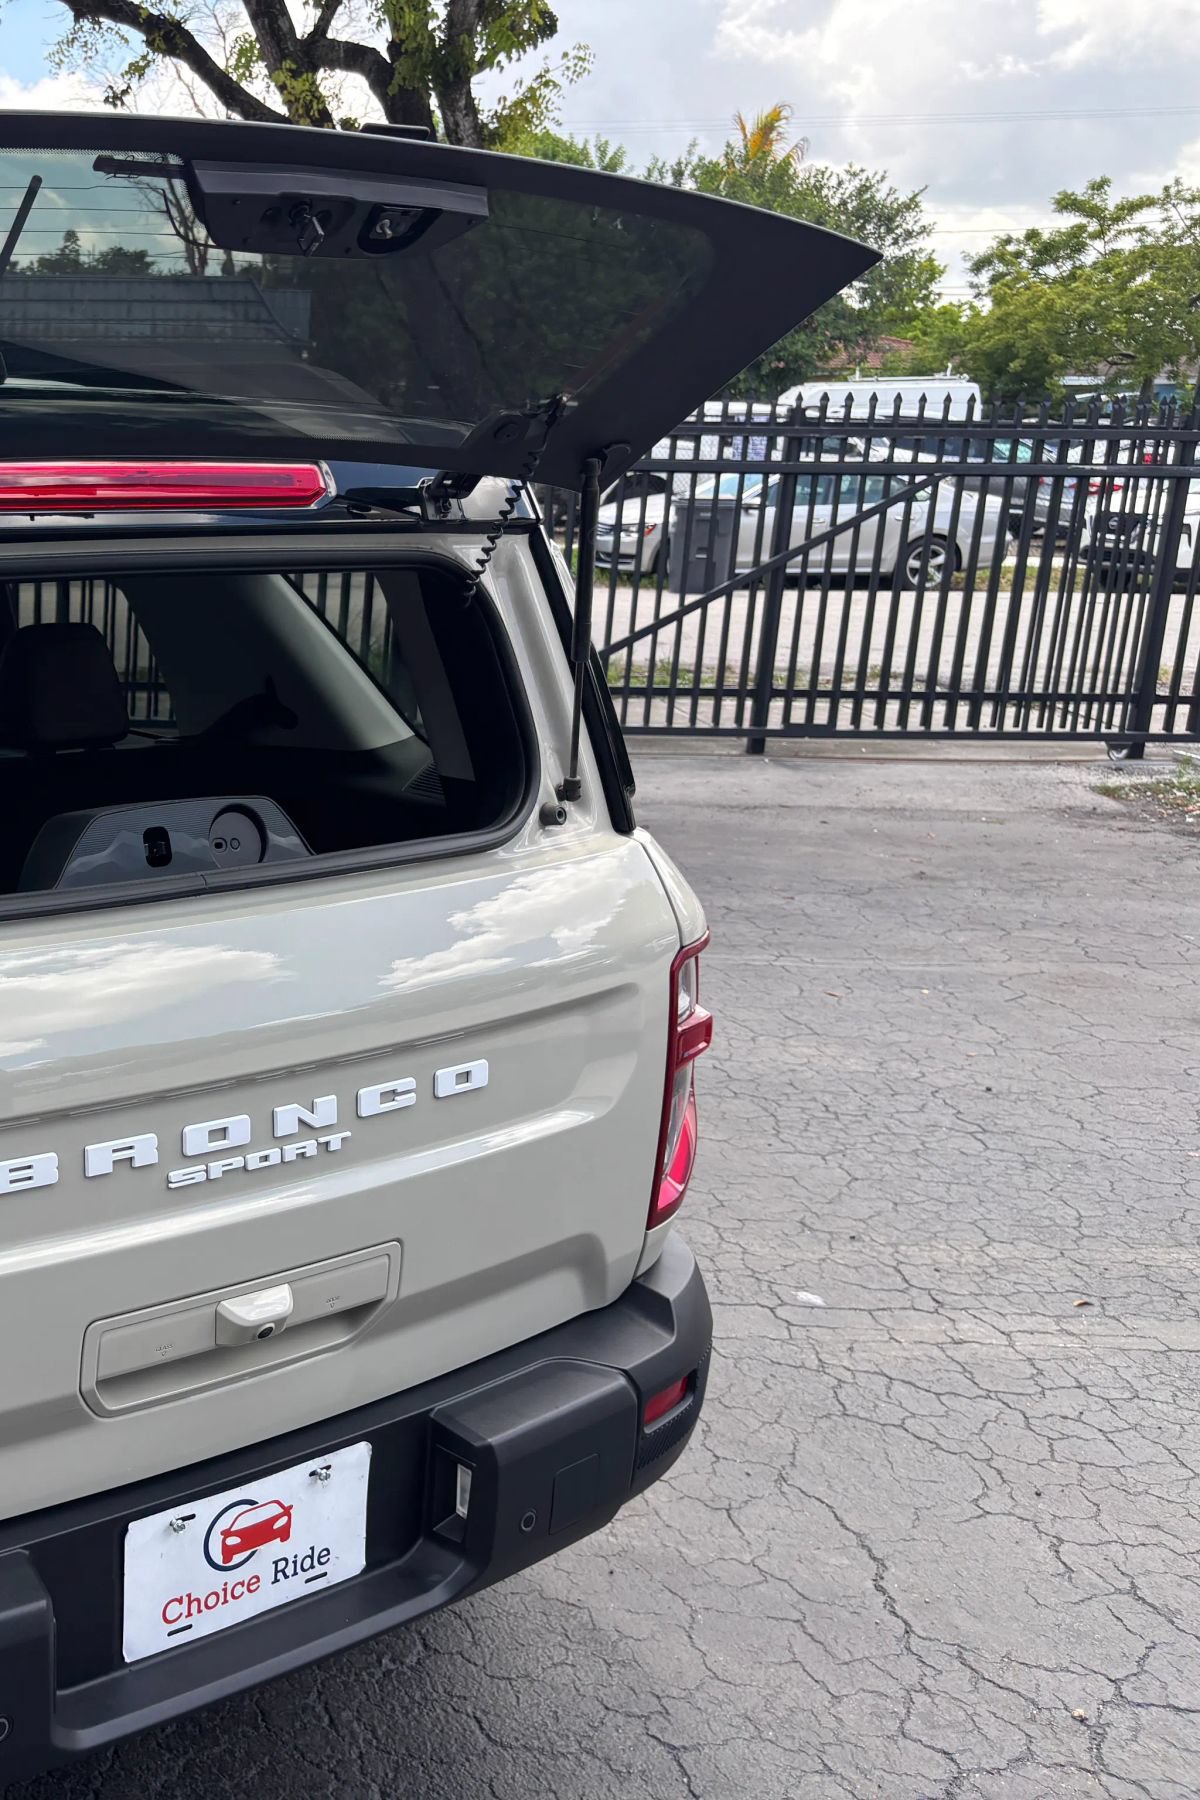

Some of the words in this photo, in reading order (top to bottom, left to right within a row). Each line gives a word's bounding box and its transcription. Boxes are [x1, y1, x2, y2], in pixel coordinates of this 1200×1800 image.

[167, 1131, 352, 1190] SPORT
[161, 1573, 261, 1625] Choice
[271, 1545, 331, 1585] Ride
